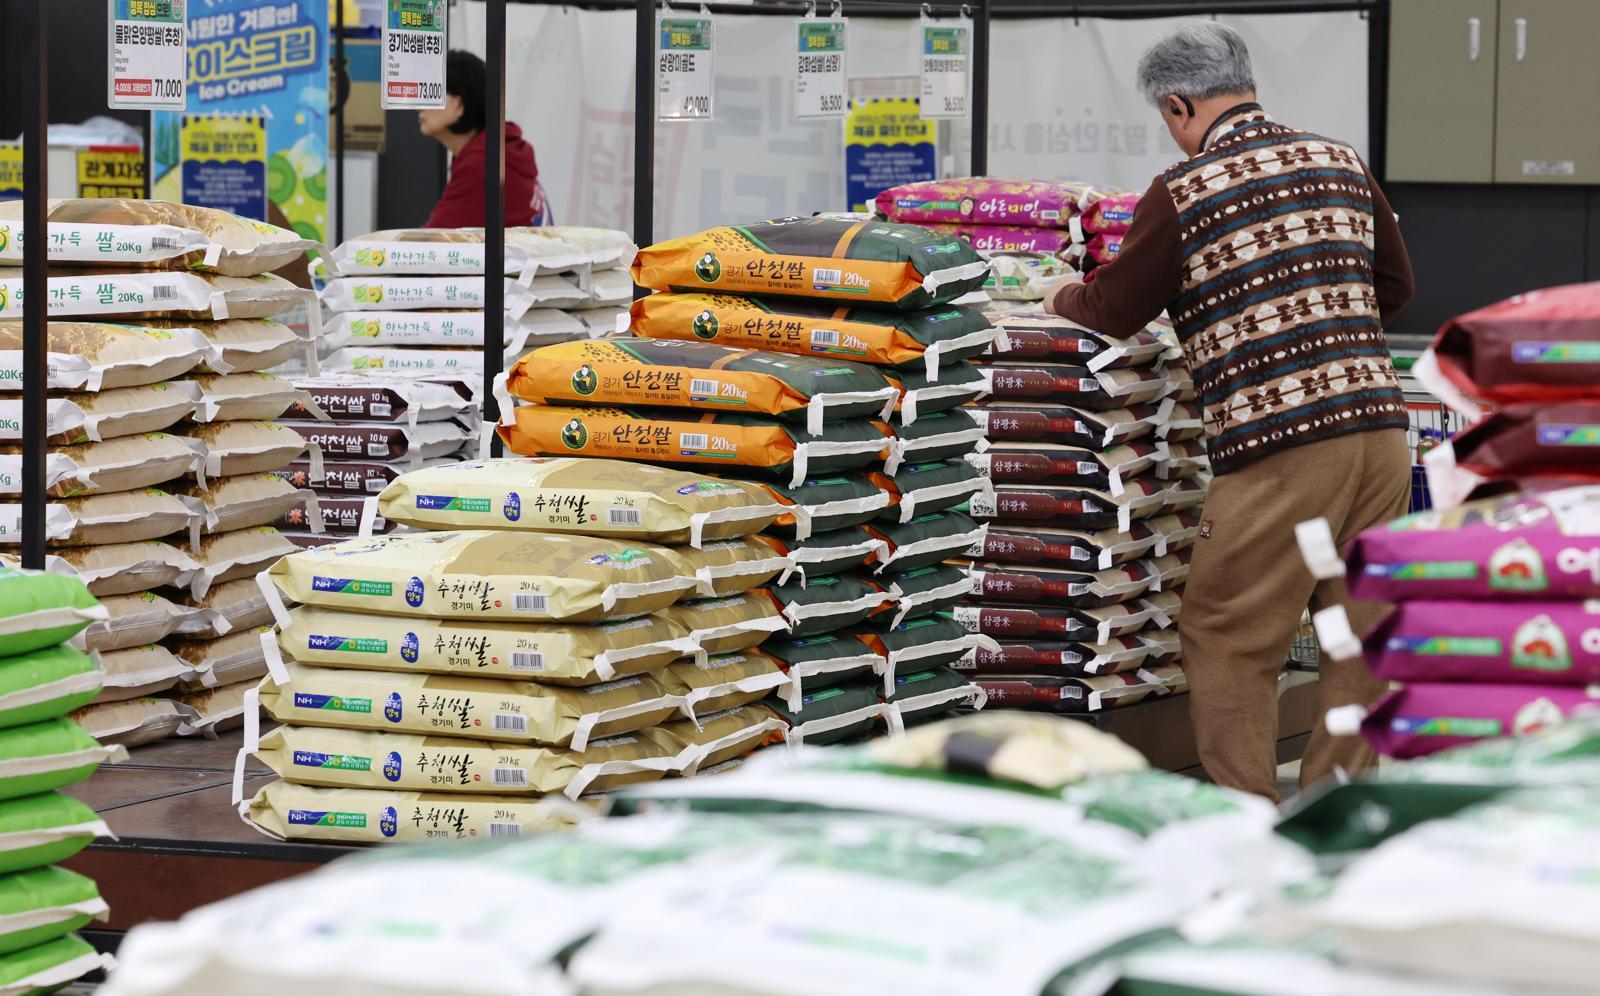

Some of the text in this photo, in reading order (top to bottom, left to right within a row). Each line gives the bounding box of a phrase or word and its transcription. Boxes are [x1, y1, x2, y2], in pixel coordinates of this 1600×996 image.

[116, 25, 183, 47] 물맑은양평쌀(추청)
[388, 33, 443, 55] 경기안성쌀(추청)
[186, 30, 312, 80] 이스크림
[660, 54, 695, 72] 삼광미골드
[155, 79, 182, 98] 71,000
[199, 75, 284, 100] Ice Cream
[419, 83, 442, 99] 73,000
[96, 231, 116, 253] 쌀
[116, 241, 142, 254] 20Kg
[391, 250, 480, 267] 하나가득 쌀 10Kg
[726, 259, 871, 288] 경기 안성쌀 20kg
[97, 283, 116, 305] 쌀
[118, 292, 144, 304] 20Kg
[388, 285, 478, 301] 하나가득 쌀 10Kg
[385, 320, 474, 337] 하나가득 쌀 10Kg
[724, 323, 742, 335] 경기
[744, 318, 804, 341] 안성쌀
[842, 334, 869, 350] 20kg
[389, 358, 435, 369] 하나가득
[602, 370, 748, 399] 경기 안성쌀 20kg
[371, 393, 380, 401] 10
[0, 419, 19, 431] 0Kg
[309, 434, 364, 453] 연천쌀
[369, 433, 379, 442] 10
[592, 424, 737, 452] 경기 안성쌀 20kg
[308, 471, 362, 489] 천쌀
[419, 498, 434, 506] NH
[534, 493, 590, 525] 추청쌀
[304, 508, 359, 526] 천쌀
[548, 514, 570, 524] 경기미
[315, 580, 330, 588] NH
[437, 579, 495, 611] 추청쌀
[450, 600, 474, 611] 경기미
[312, 638, 327, 647] NH
[433, 634, 491, 667] 추청쌀
[448, 657, 471, 667] 경기미
[297, 696, 312, 704] NH
[417, 694, 474, 729] 추청쌀
[430, 718, 454, 728] 경기미
[297, 754, 312, 763] NH
[416, 753, 474, 785] 추청쌀
[430, 775, 453, 785] 경기미
[291, 813, 307, 821] NH
[411, 807, 469, 840] 추청쌀
[425, 829, 448, 839] 경기미
